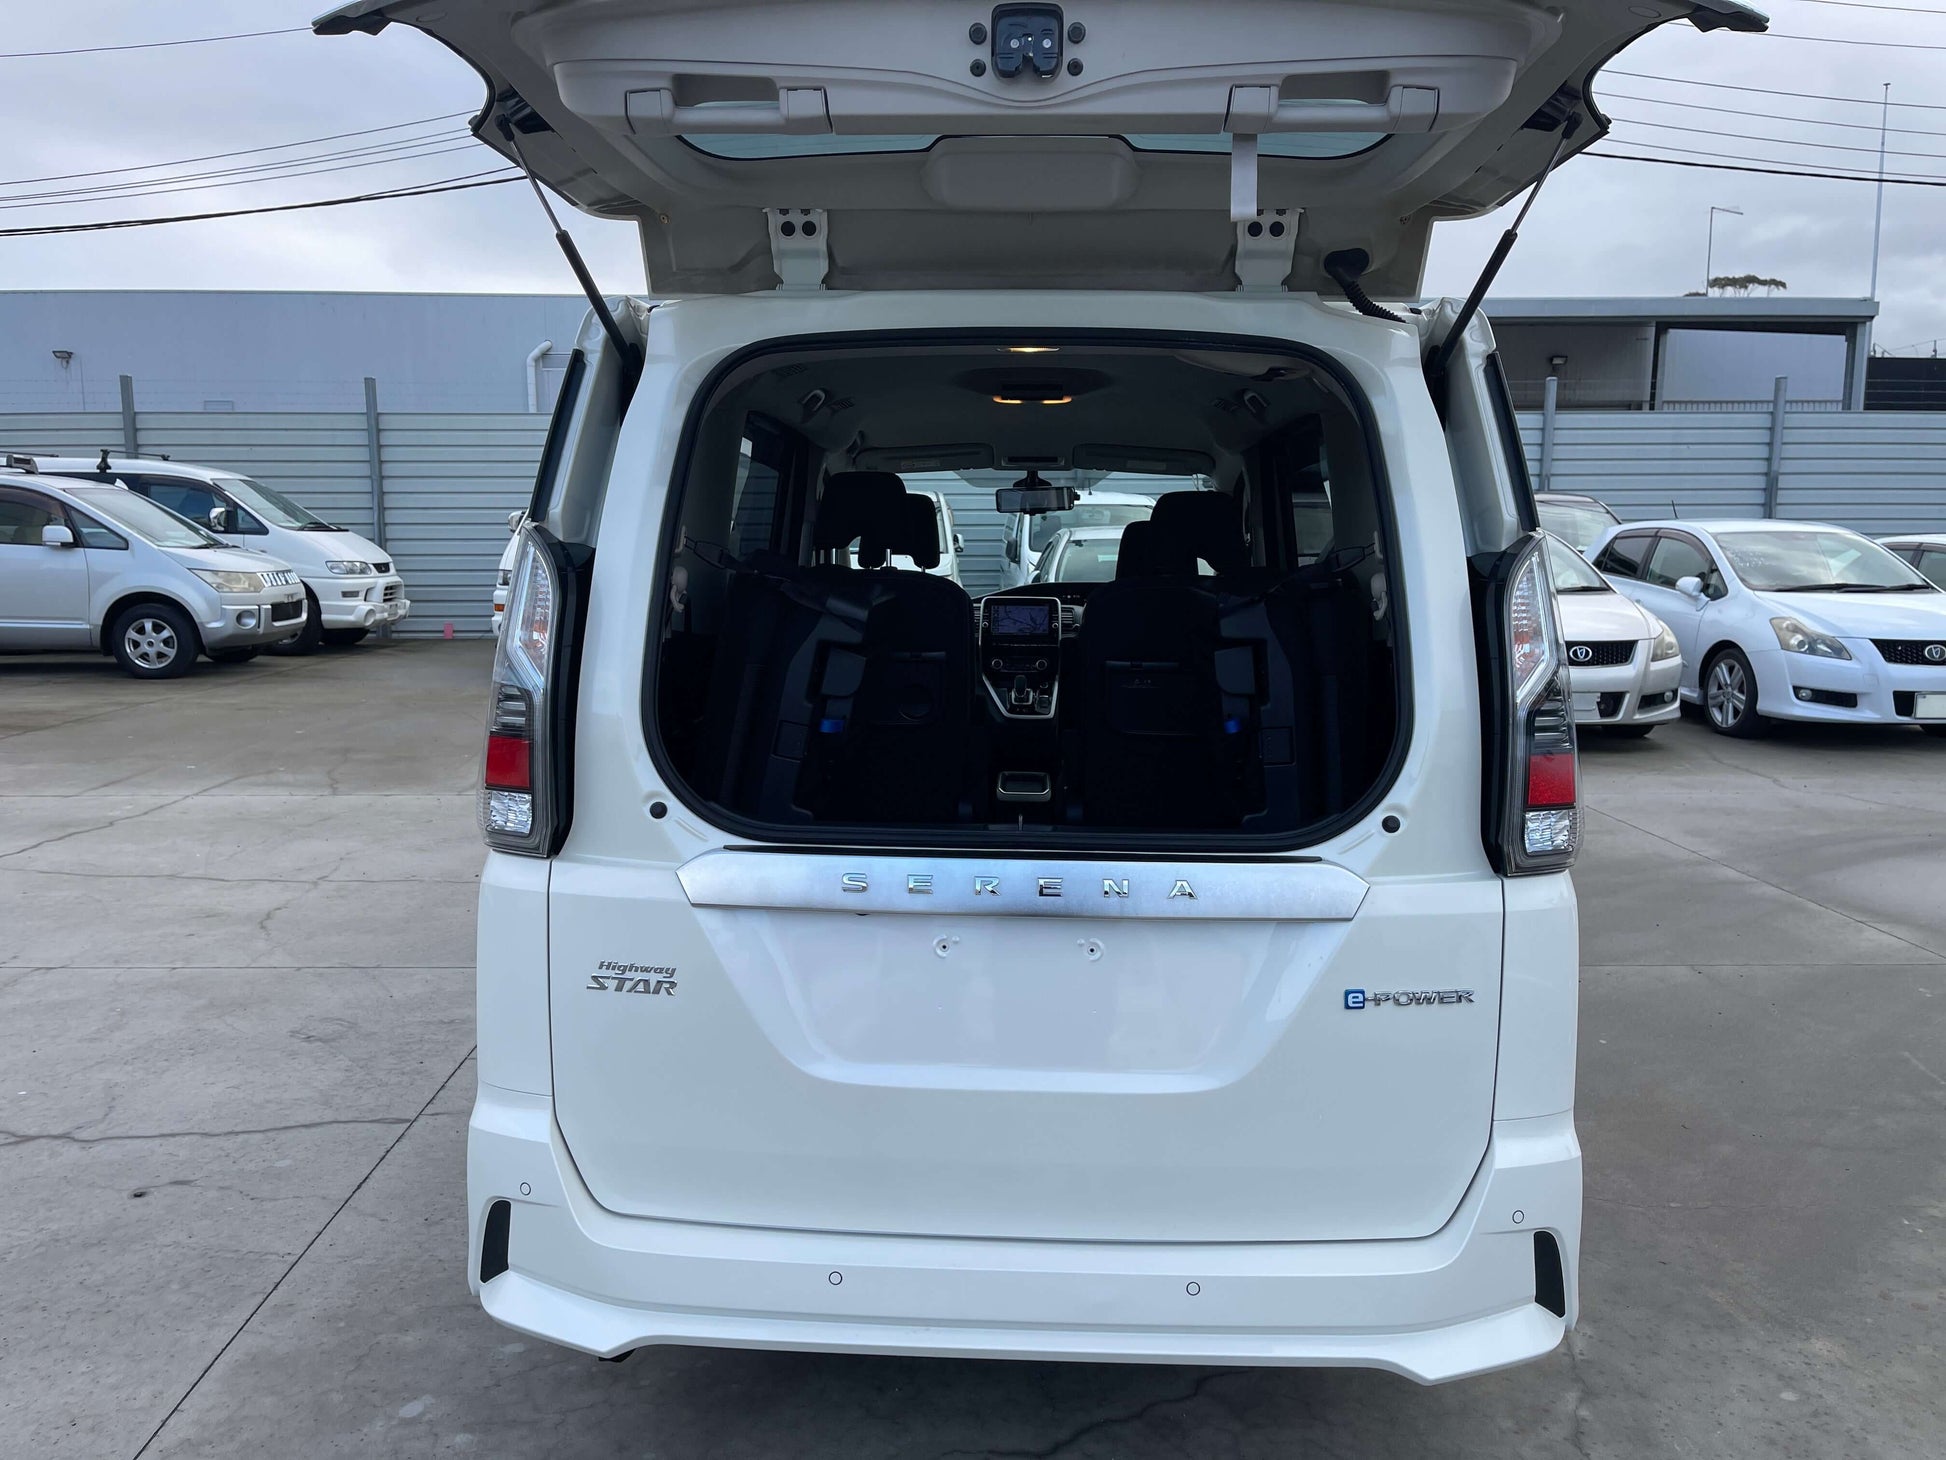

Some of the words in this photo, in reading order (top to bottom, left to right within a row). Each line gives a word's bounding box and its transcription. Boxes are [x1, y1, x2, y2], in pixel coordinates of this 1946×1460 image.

[841, 871, 1199, 900] SERENA
[597, 960, 677, 979] Highway
[586, 973, 678, 997] STAR
[1344, 988, 1475, 1009] e-POWER
